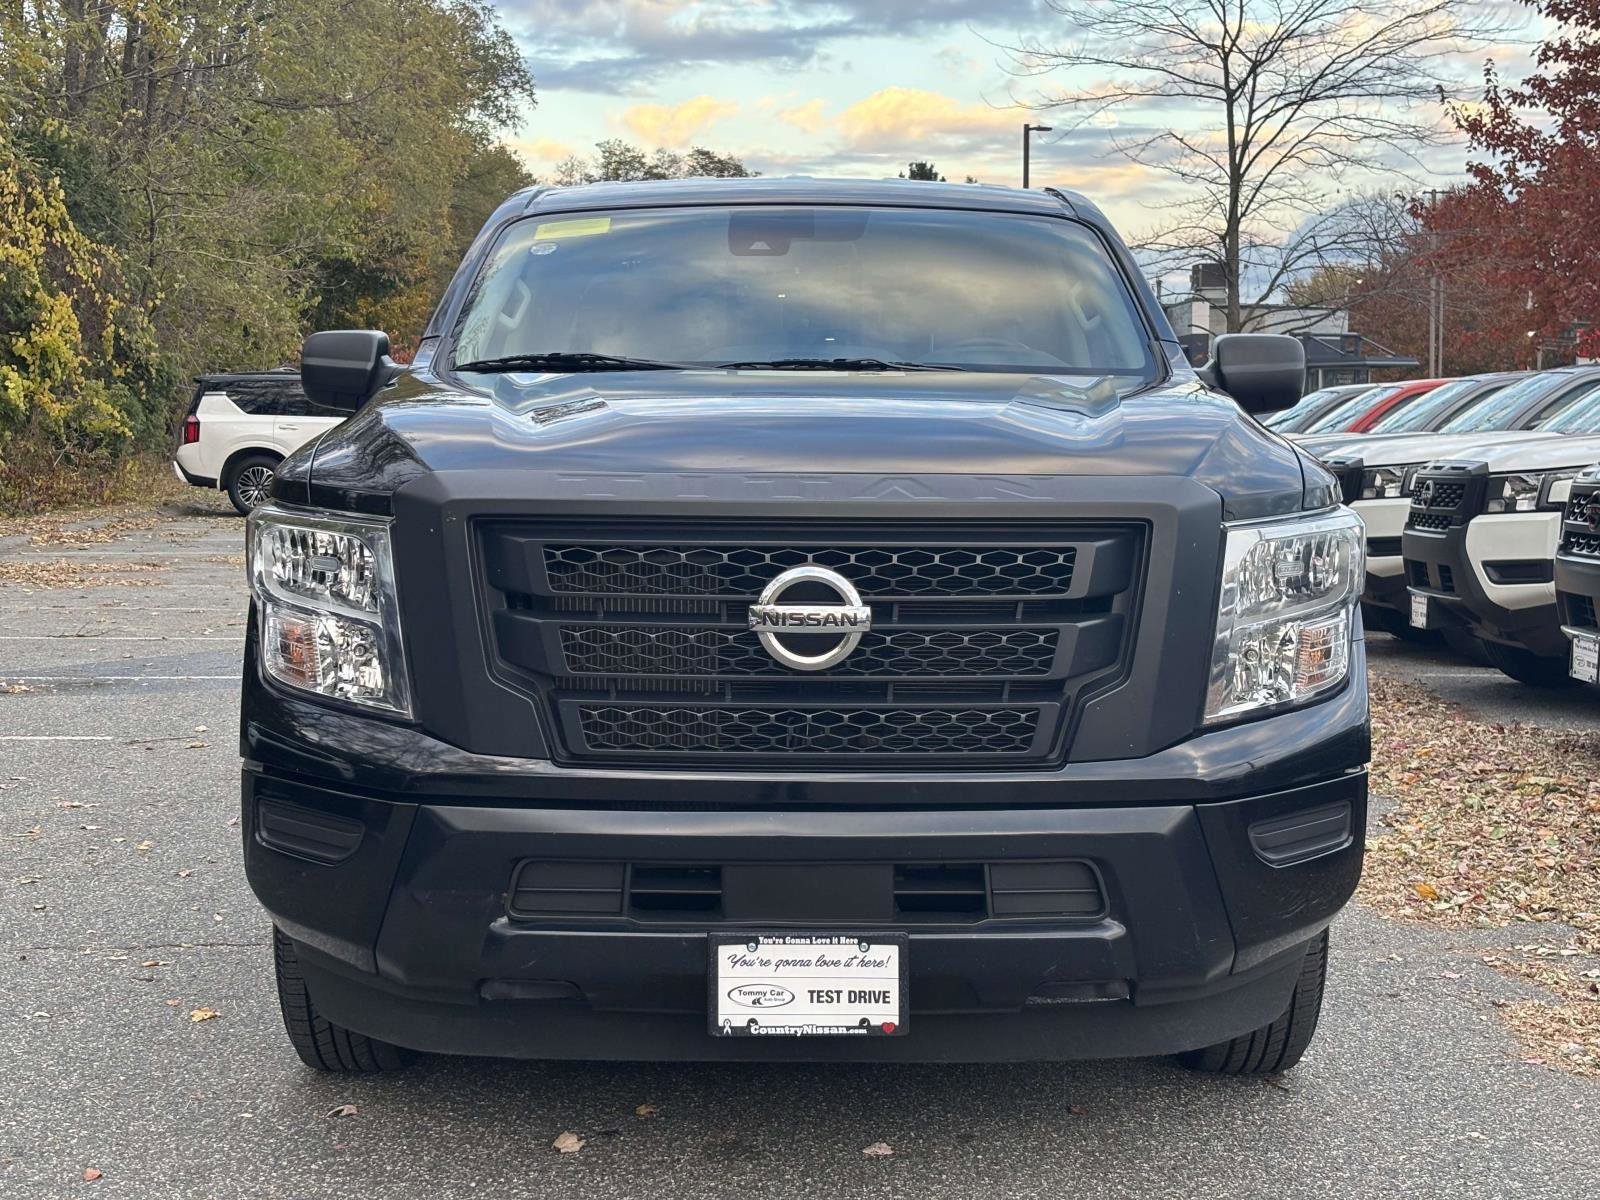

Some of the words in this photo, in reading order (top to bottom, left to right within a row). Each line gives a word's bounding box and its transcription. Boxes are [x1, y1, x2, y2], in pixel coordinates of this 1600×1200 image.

[762, 612, 858, 626] NISSAN
[727, 954, 772, 969] You're
[774, 959, 813, 972] gonna
[814, 954, 842, 968] love
[843, 955, 859, 968] it
[856, 955, 892, 968] here!
[769, 989, 785, 997] Car
[807, 990, 843, 1004] TEST
[847, 990, 891, 1004] DRIVE
[750, 1024, 867, 1036] CountryNissan.com
